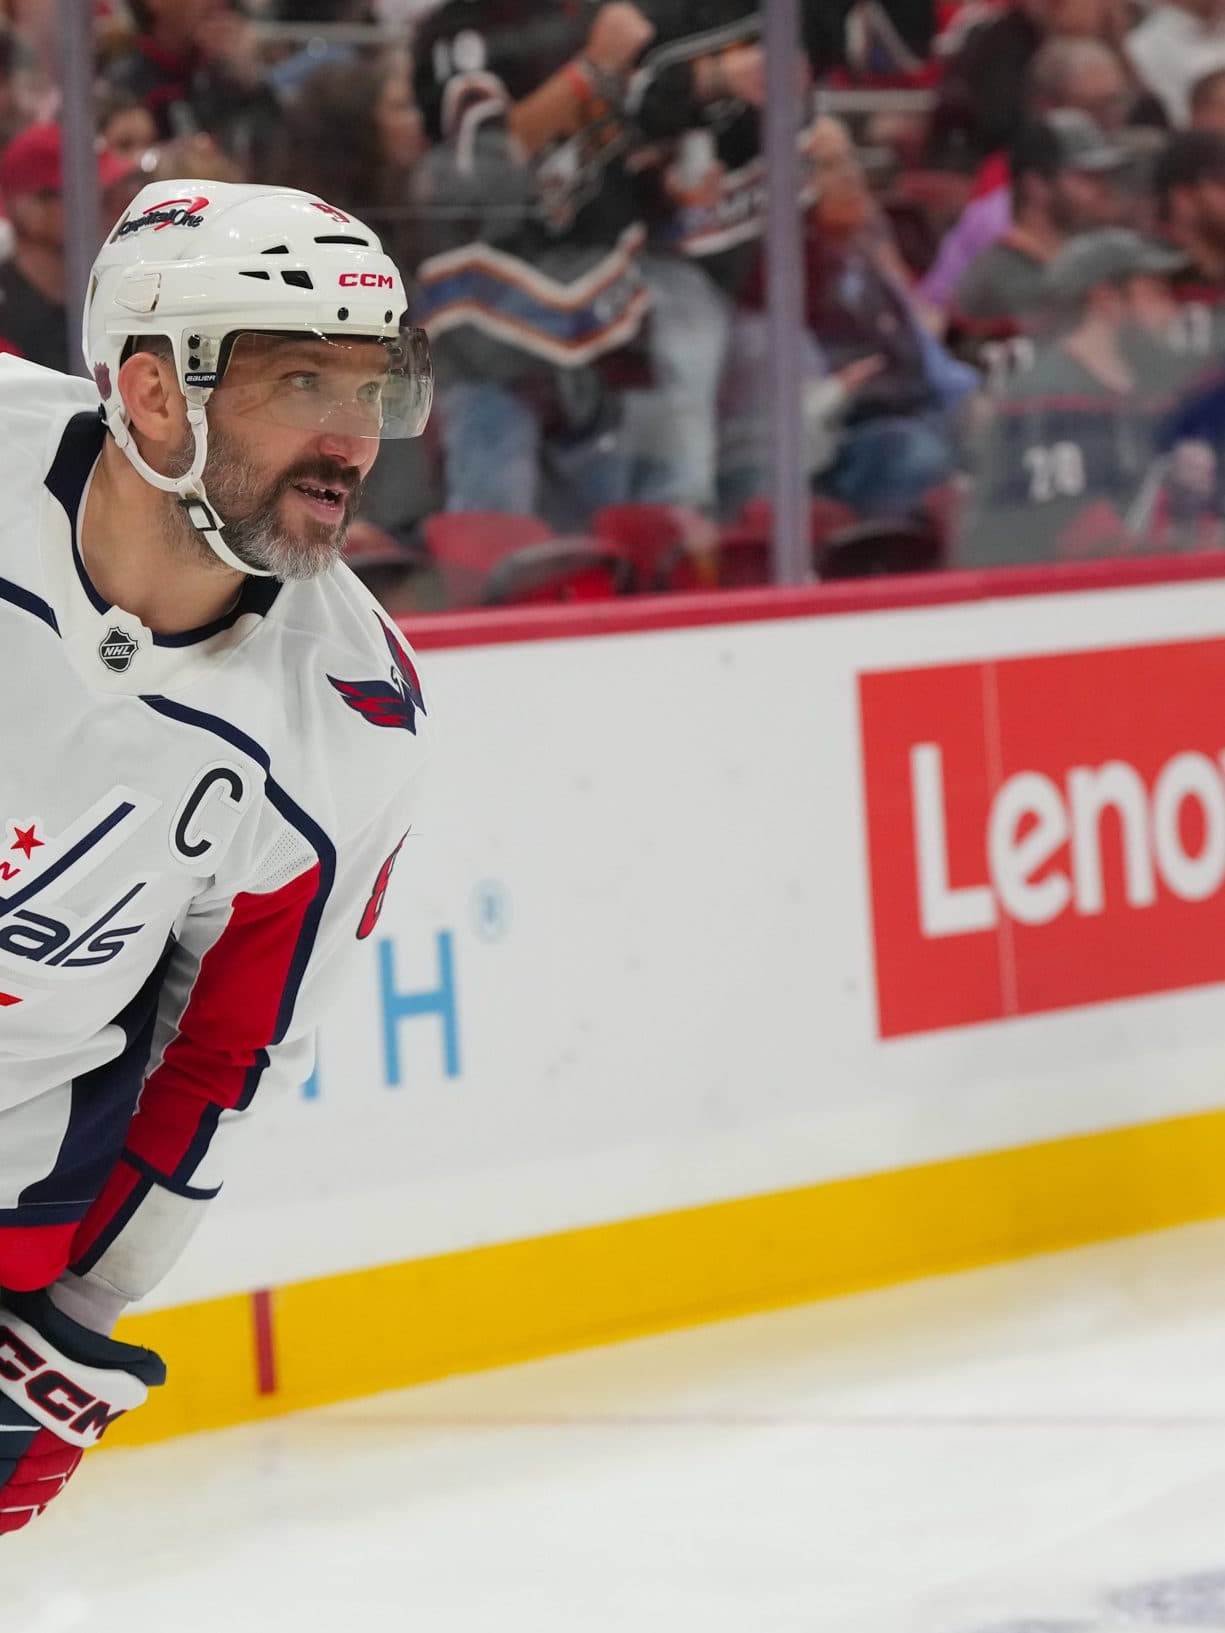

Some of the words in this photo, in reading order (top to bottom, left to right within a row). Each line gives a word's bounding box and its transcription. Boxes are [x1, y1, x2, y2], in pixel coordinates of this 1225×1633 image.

[338, 273, 393, 290] CCM
[103, 645, 131, 657] NHL
[175, 767, 244, 858] C
[910, 741, 1225, 940] Leno
